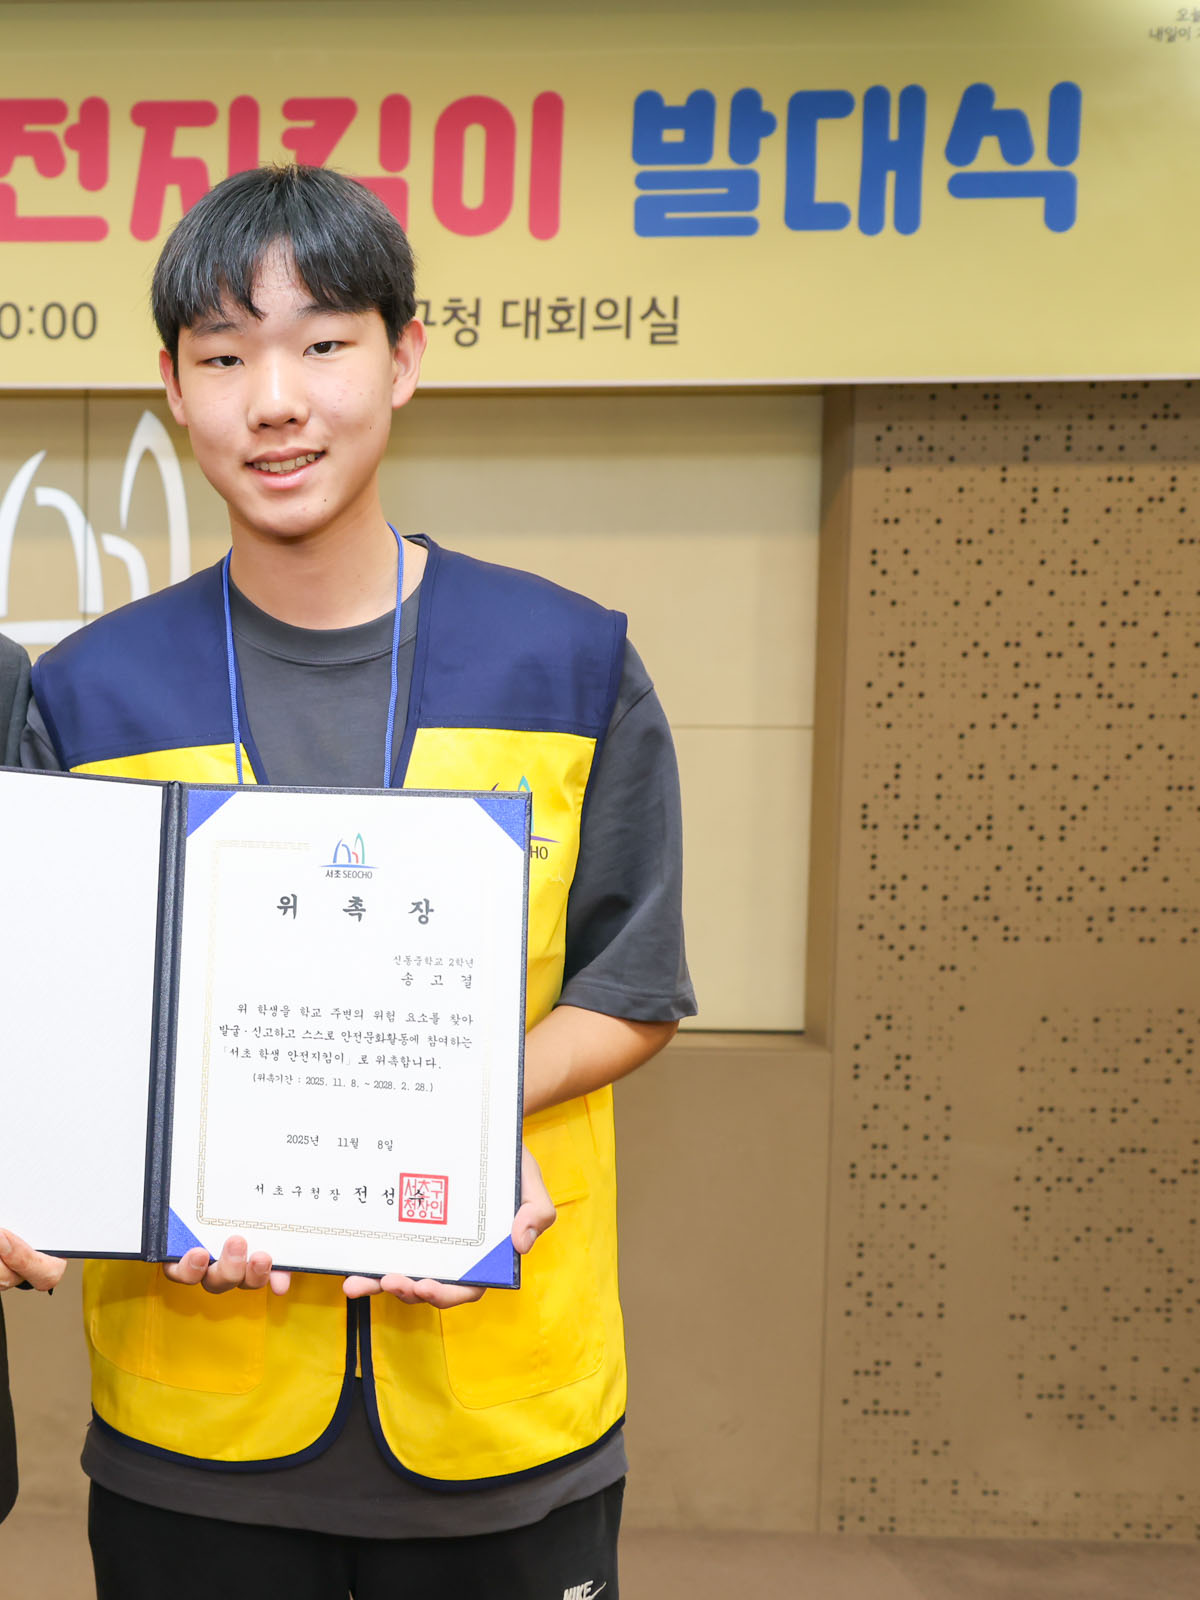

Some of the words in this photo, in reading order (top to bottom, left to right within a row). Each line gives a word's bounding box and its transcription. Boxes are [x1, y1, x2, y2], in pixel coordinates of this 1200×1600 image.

[631, 81, 1082, 238] 발대식
[502, 295, 679, 346] 대회의실
[325, 869, 341, 879] 서초
[343, 869, 373, 879] SEOCHO
[448, 957, 474, 969] 2학년
[237, 1003, 247, 1015] 위
[257, 1004, 291, 1018] 학생을
[300, 1006, 322, 1018] 학교
[330, 1007, 364, 1021] 주변의
[373, 1009, 396, 1023] 위험
[405, 1012, 441, 1026] 요소를
[301, 1029, 335, 1041] 스스로
[427, 1034, 473, 1048] 참여하는
[258, 1048, 280, 1062] 학생
[375, 1054, 442, 1070] 위촉합니다.
[286, 1134, 319, 1147] 2025년
[337, 1137, 359, 1150] 11월
[377, 1139, 393, 1152] 8일
[563, 1580, 594, 1600] NIKE
